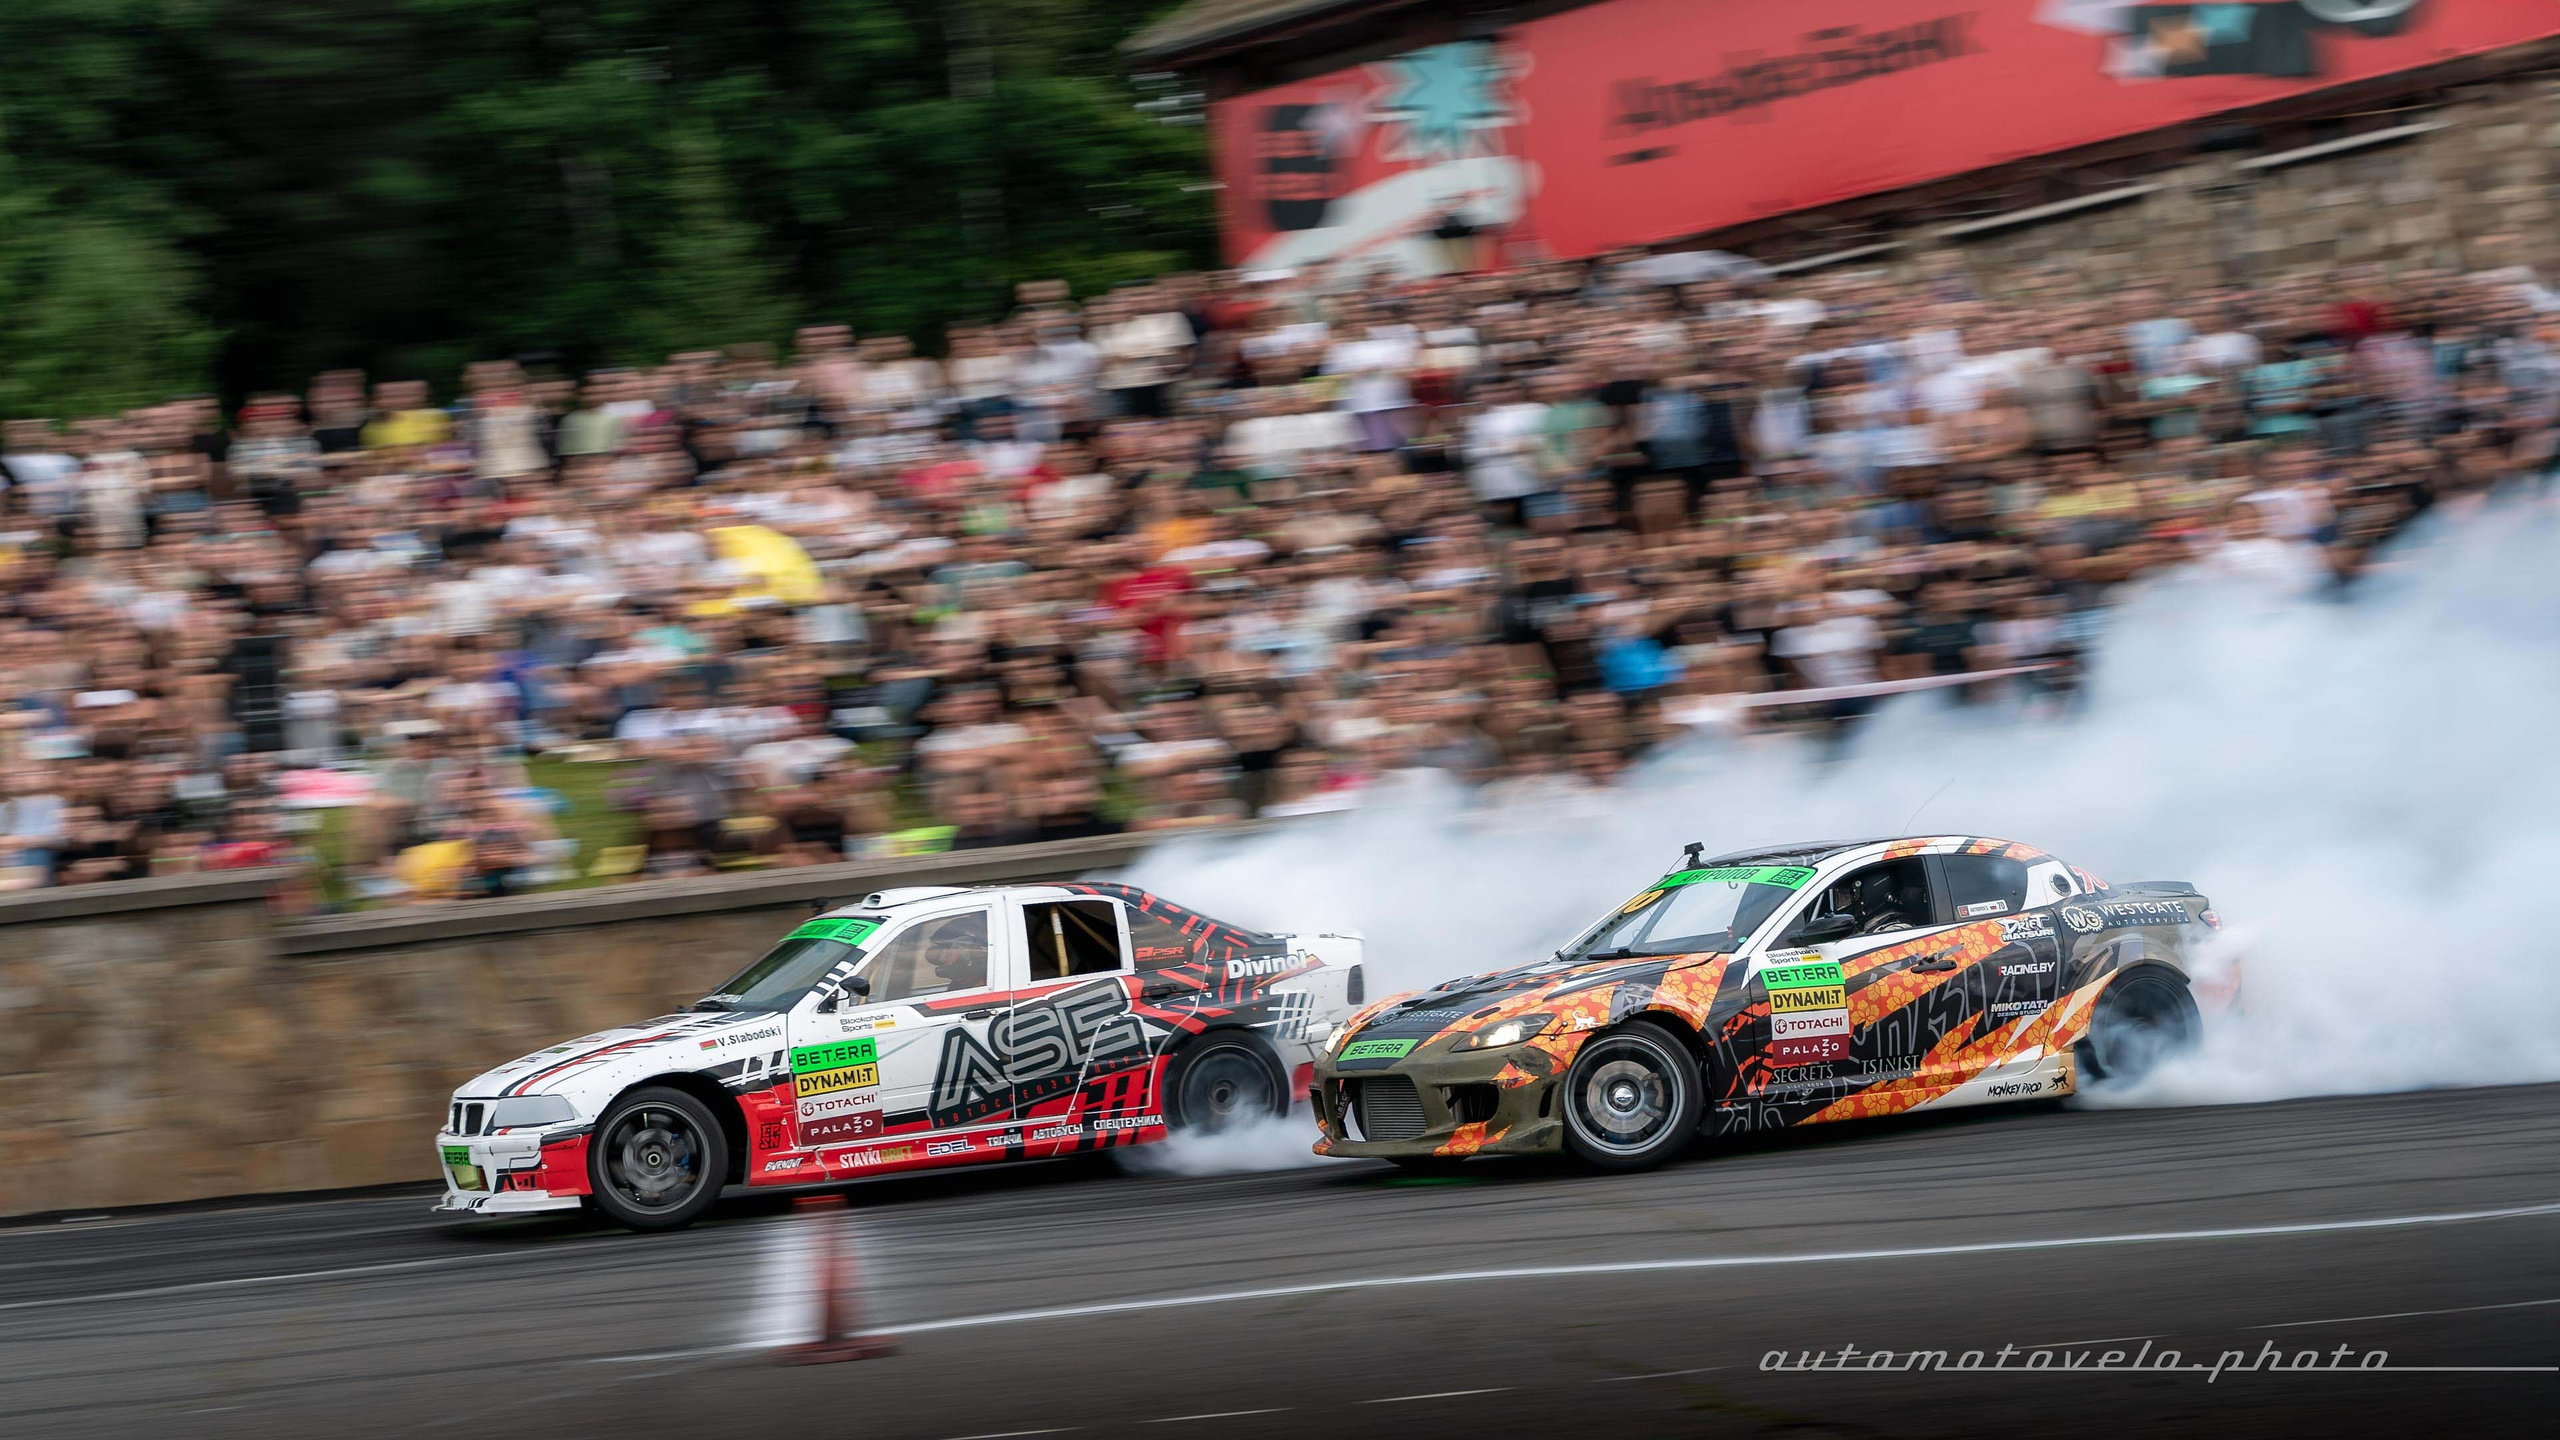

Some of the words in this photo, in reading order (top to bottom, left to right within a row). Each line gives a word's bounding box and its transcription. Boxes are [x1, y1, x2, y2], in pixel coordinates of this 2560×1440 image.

[2098, 901, 2185, 916] WESTGATE
[2065, 910, 2101, 928] WG
[2107, 917, 2190, 927] AUTOSERVICE
[2002, 928, 2055, 942] MATSURI
[1766, 949, 1814, 959] Blockchain
[1769, 957, 1800, 965] Sports
[1226, 949, 1308, 979] Divinol
[1766, 966, 1839, 983] BET.ERA
[1773, 989, 1841, 1009] DYNAMI:T
[1991, 999, 2048, 1013] MIKOTATI
[840, 1013, 890, 1026] Blockchain
[1997, 1010, 2019, 1018] DESIGN
[2020, 1008, 2042, 1016] STUDIO
[841, 1022, 873, 1034] Sports
[1789, 1017, 1843, 1031] TOTACHI
[718, 1026, 782, 1047] V.Slabodski
[796, 1043, 873, 1067] BET.ERA
[936, 984, 1140, 1111] ASE
[1350, 1043, 1403, 1056] BET.ERA
[1782, 1038, 1840, 1057] PALAZZO
[1861, 1054, 1920, 1075] TSINIST
[800, 1068, 873, 1092] DYNAMI:T
[1773, 1064, 1834, 1084] SECRETS
[1987, 1081, 2020, 1097] MONKEY
[2021, 1082, 2043, 1096] PROD
[816, 1094, 875, 1112] TOTACHI
[810, 1116, 874, 1136] PALAZZO
[1093, 1114, 1164, 1131] СПЕЦТЕХНИКА
[986, 1133, 1023, 1147] ТЯГАЧИ
[1032, 1124, 1083, 1141] АВТОБУСЫ
[928, 1138, 975, 1156] EDEL
[764, 1157, 804, 1172] BURNOUT
